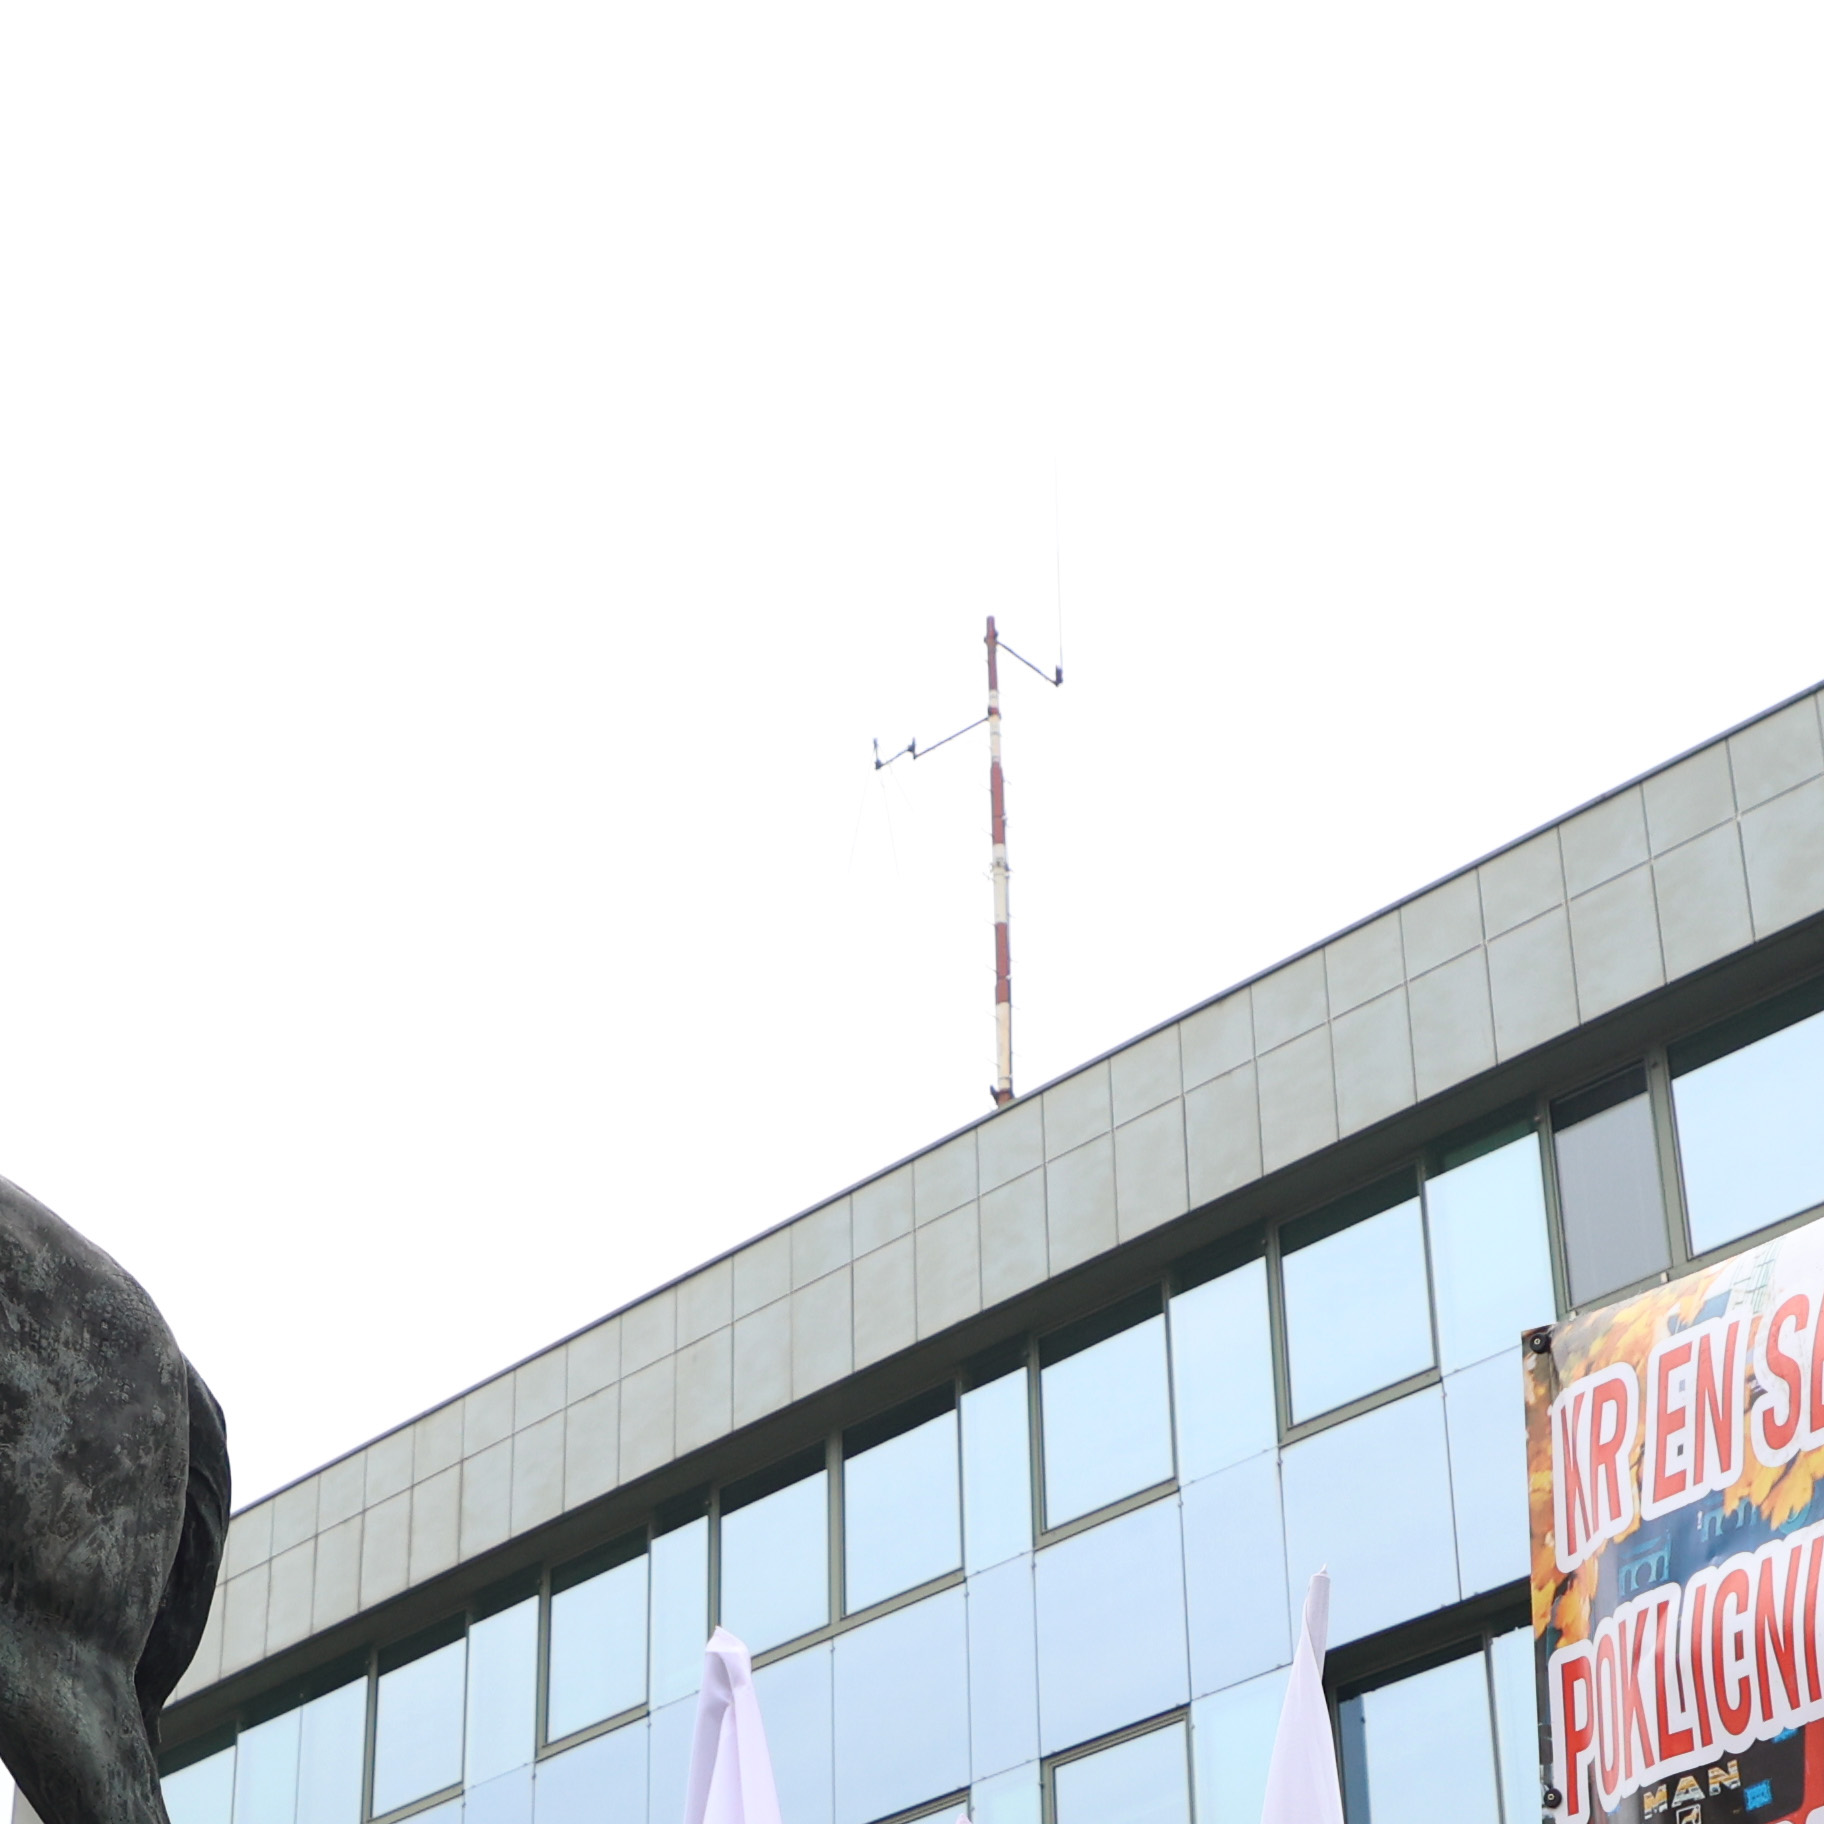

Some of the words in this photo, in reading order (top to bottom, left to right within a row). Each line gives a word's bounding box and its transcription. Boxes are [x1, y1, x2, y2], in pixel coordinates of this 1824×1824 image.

[1558, 1378, 1627, 1557] KR
[1652, 1319, 1740, 1504] EN
[1642, 1758, 1742, 1821] MAN
